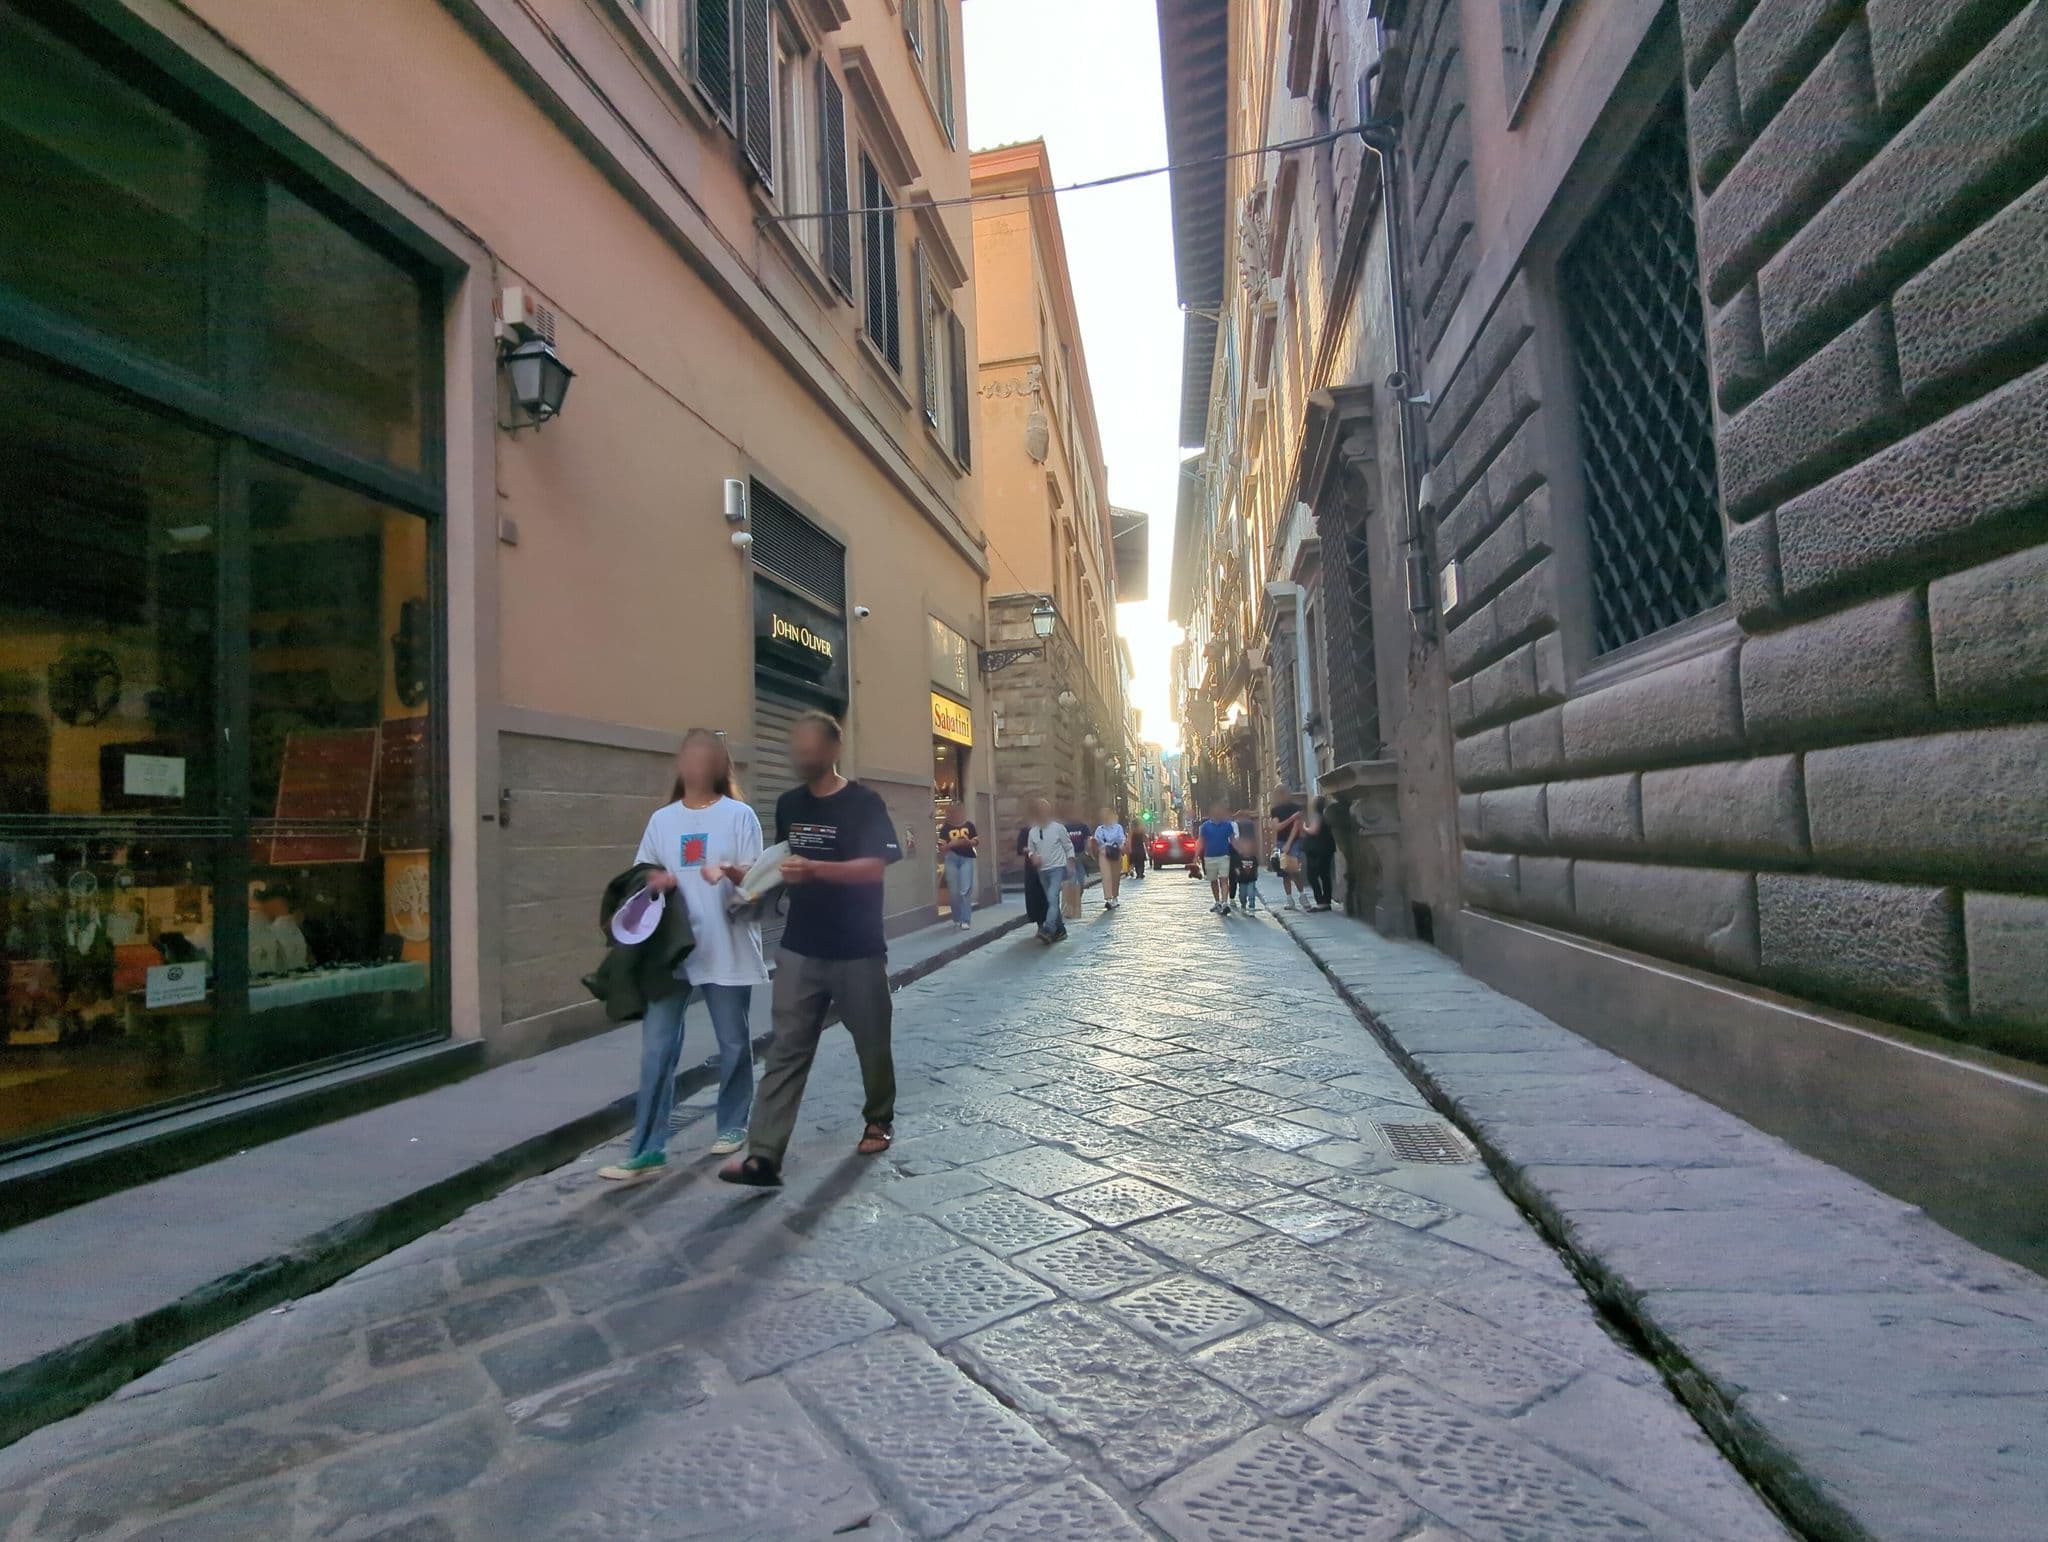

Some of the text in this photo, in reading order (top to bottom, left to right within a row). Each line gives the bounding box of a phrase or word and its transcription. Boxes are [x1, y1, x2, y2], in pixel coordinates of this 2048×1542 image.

[772, 613, 833, 658] JOHN OLIVER
[934, 703, 970, 738] Sabatini
